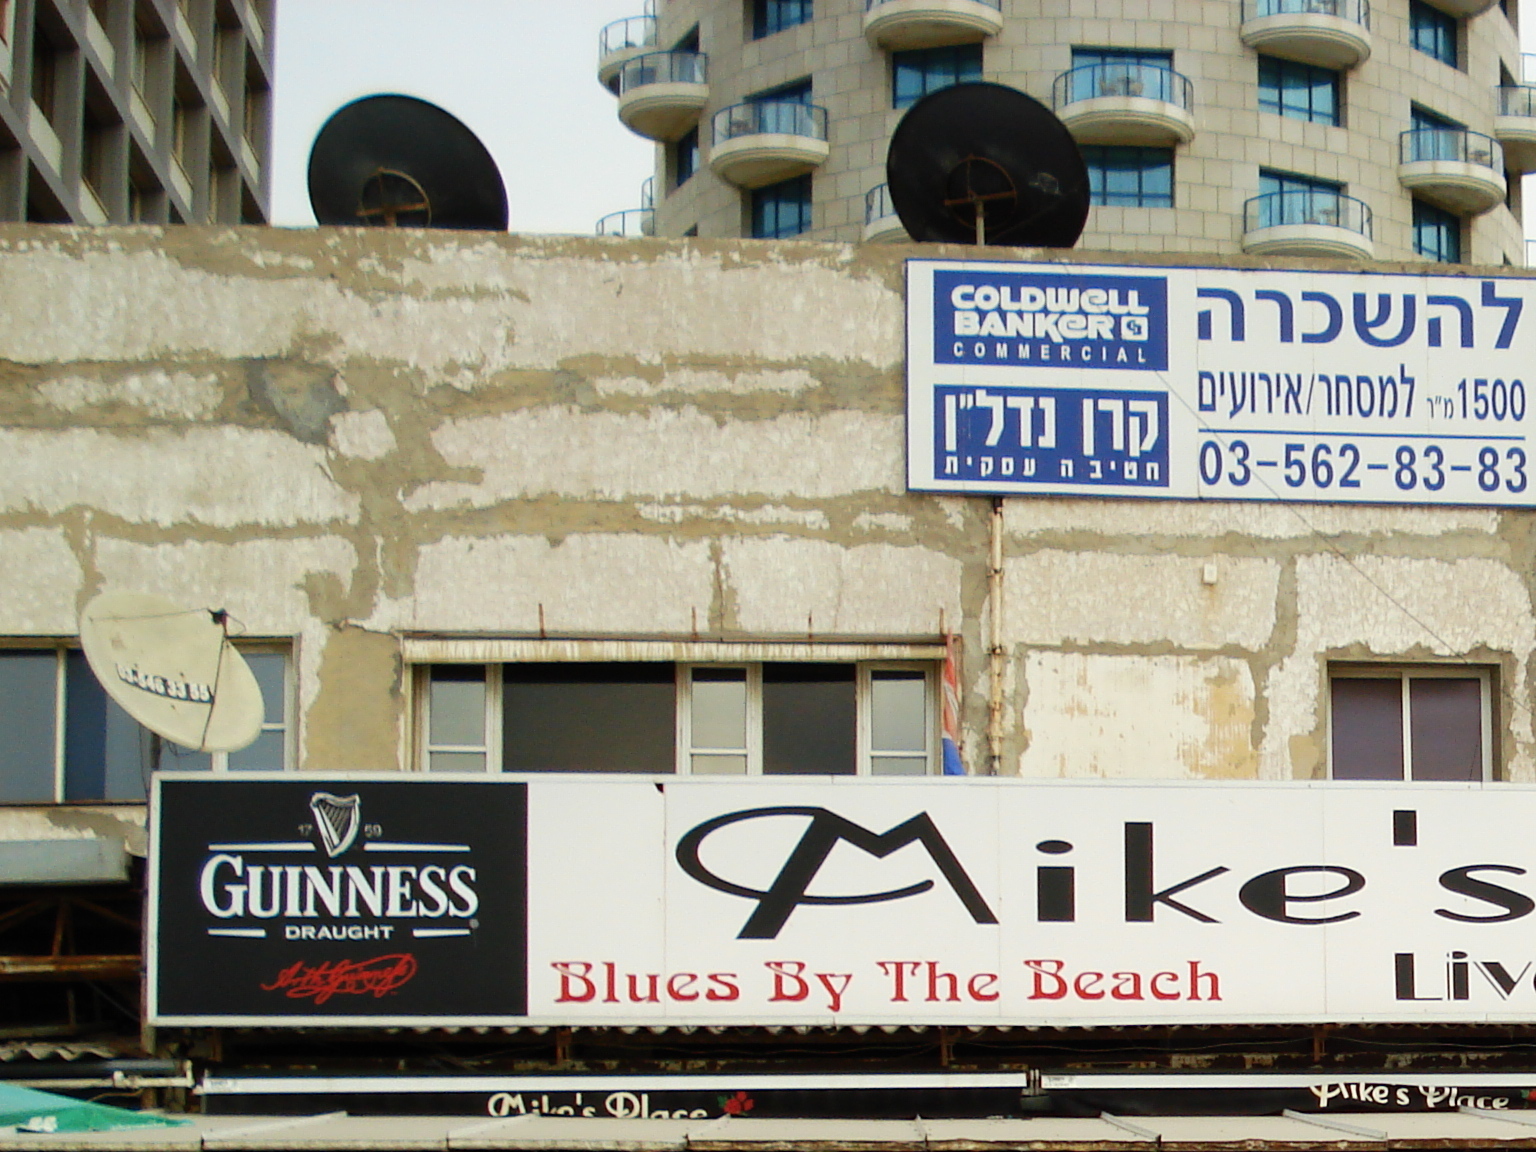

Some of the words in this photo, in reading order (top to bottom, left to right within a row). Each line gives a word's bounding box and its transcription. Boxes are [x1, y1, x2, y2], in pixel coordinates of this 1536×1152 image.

[954, 310, 1114, 343] BANKER
[1197, 281, 1523, 349] להשכרה
[953, 341, 1147, 363] COMMERCIAL
[1198, 363, 1415, 419] למסחר/אירועים
[1457, 378, 1526, 421] 1500
[1082, 398, 1159, 457] קרן
[944, 456, 1036, 477] עסקית
[1060, 459, 1160, 481] חטיבה
[1199, 439, 1528, 493] 03-562-83-83
[200, 854, 479, 918] GUINNESS
[675, 805, 1536, 939] Mike's
[284, 925, 395, 940] DRAUGHT
[551, 961, 741, 1004] Blues
[764, 960, 853, 1012] By
[876, 960, 1000, 1004] The
[1023, 959, 1223, 1003] Beach
